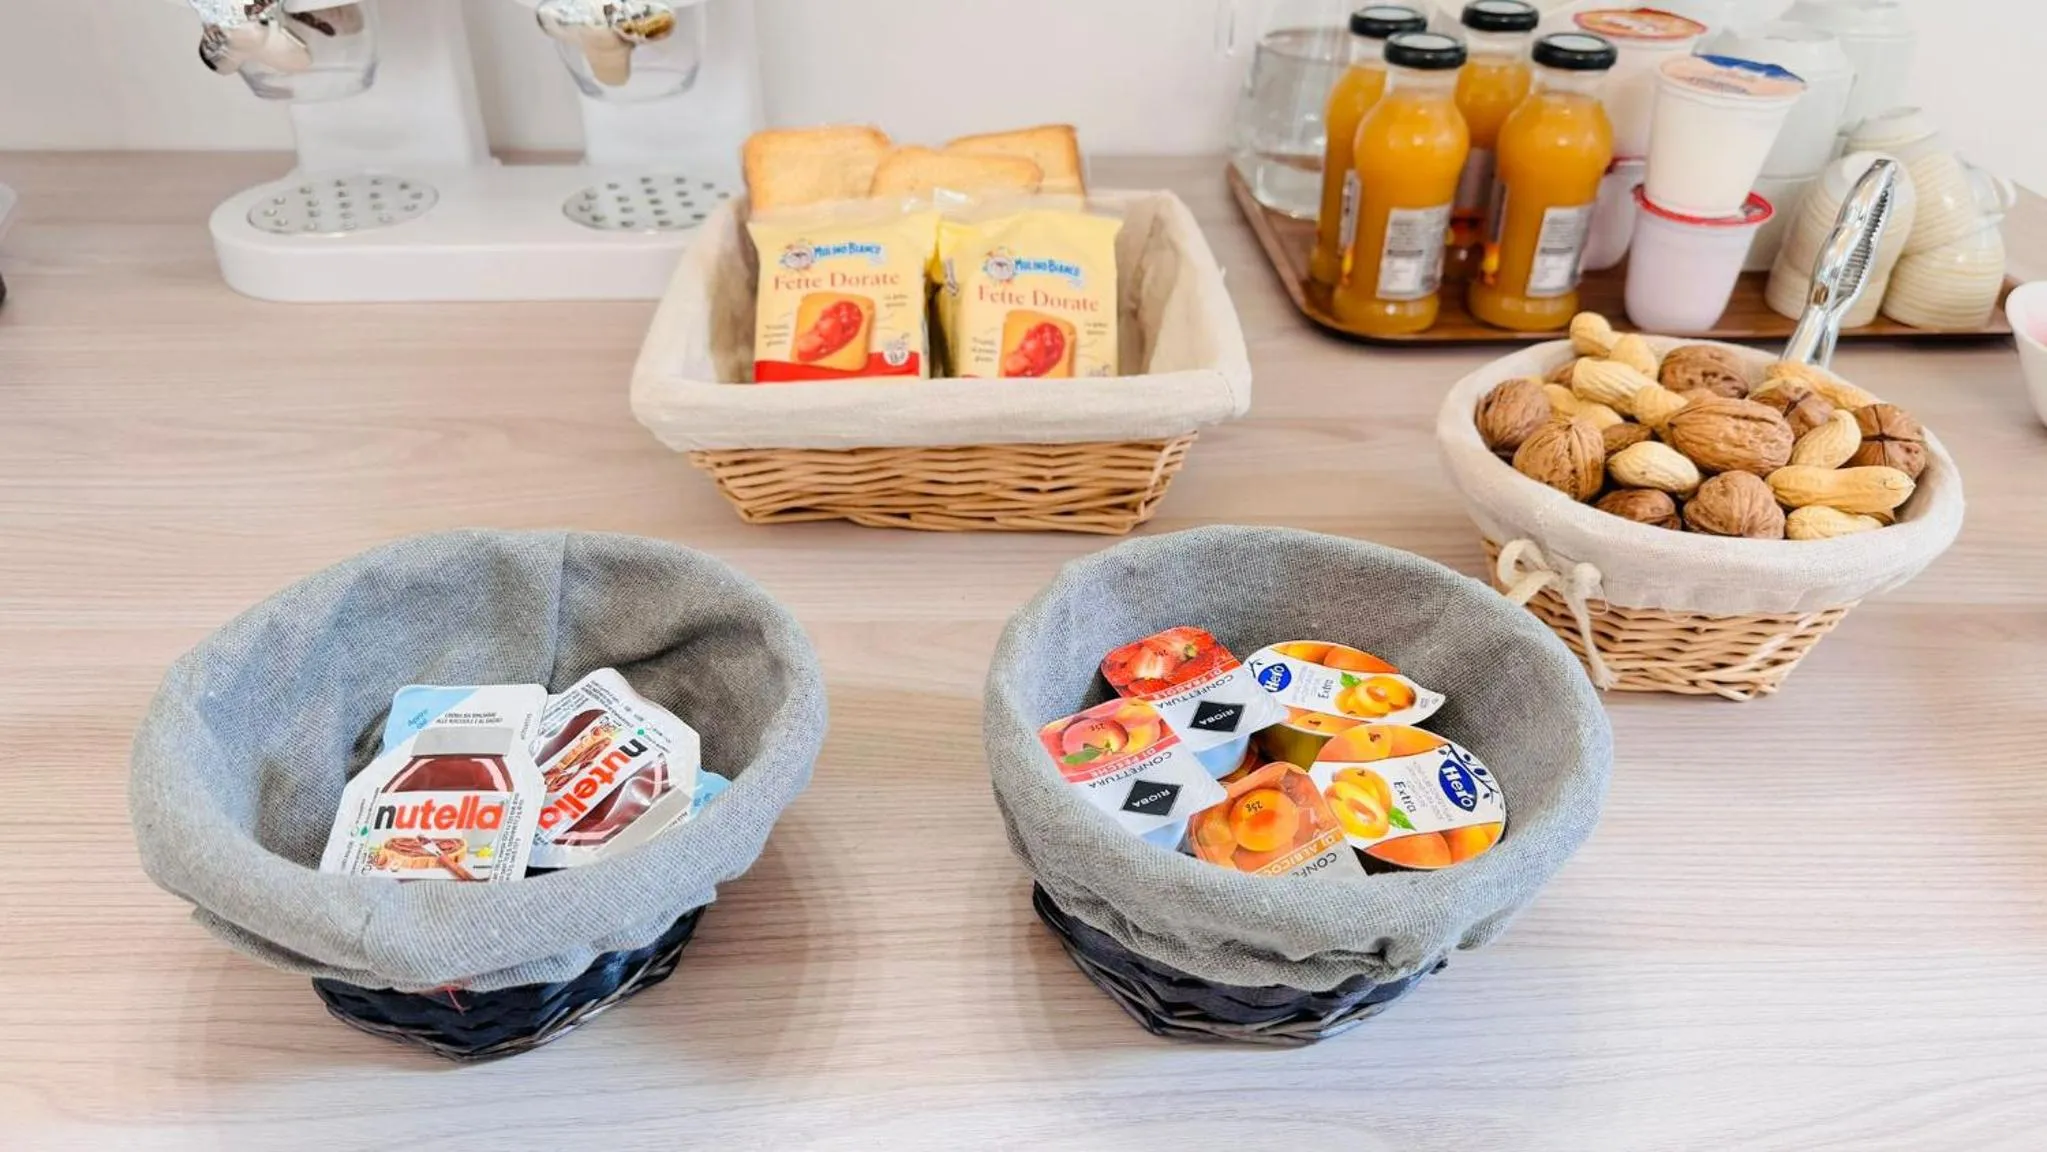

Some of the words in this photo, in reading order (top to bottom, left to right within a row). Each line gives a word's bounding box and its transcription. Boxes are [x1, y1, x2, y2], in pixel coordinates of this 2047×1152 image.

[774, 274, 823, 291] Fette
[830, 272, 900, 287] Dorate
[978, 285, 1025, 306] Fette
[1033, 289, 1100, 312] Dorate
[1156, 674, 1233, 709] CONFETTURA
[1263, 665, 1285, 691] Hero
[1200, 708, 1234, 726] RIOBA
[538, 738, 648, 831] nutella
[1088, 751, 1172, 789] CONFETTURA
[1132, 788, 1171, 808] RIOBA
[1394, 781, 1417, 814] Extra
[1441, 766, 1474, 808] Hero
[374, 796, 504, 830] nutella
